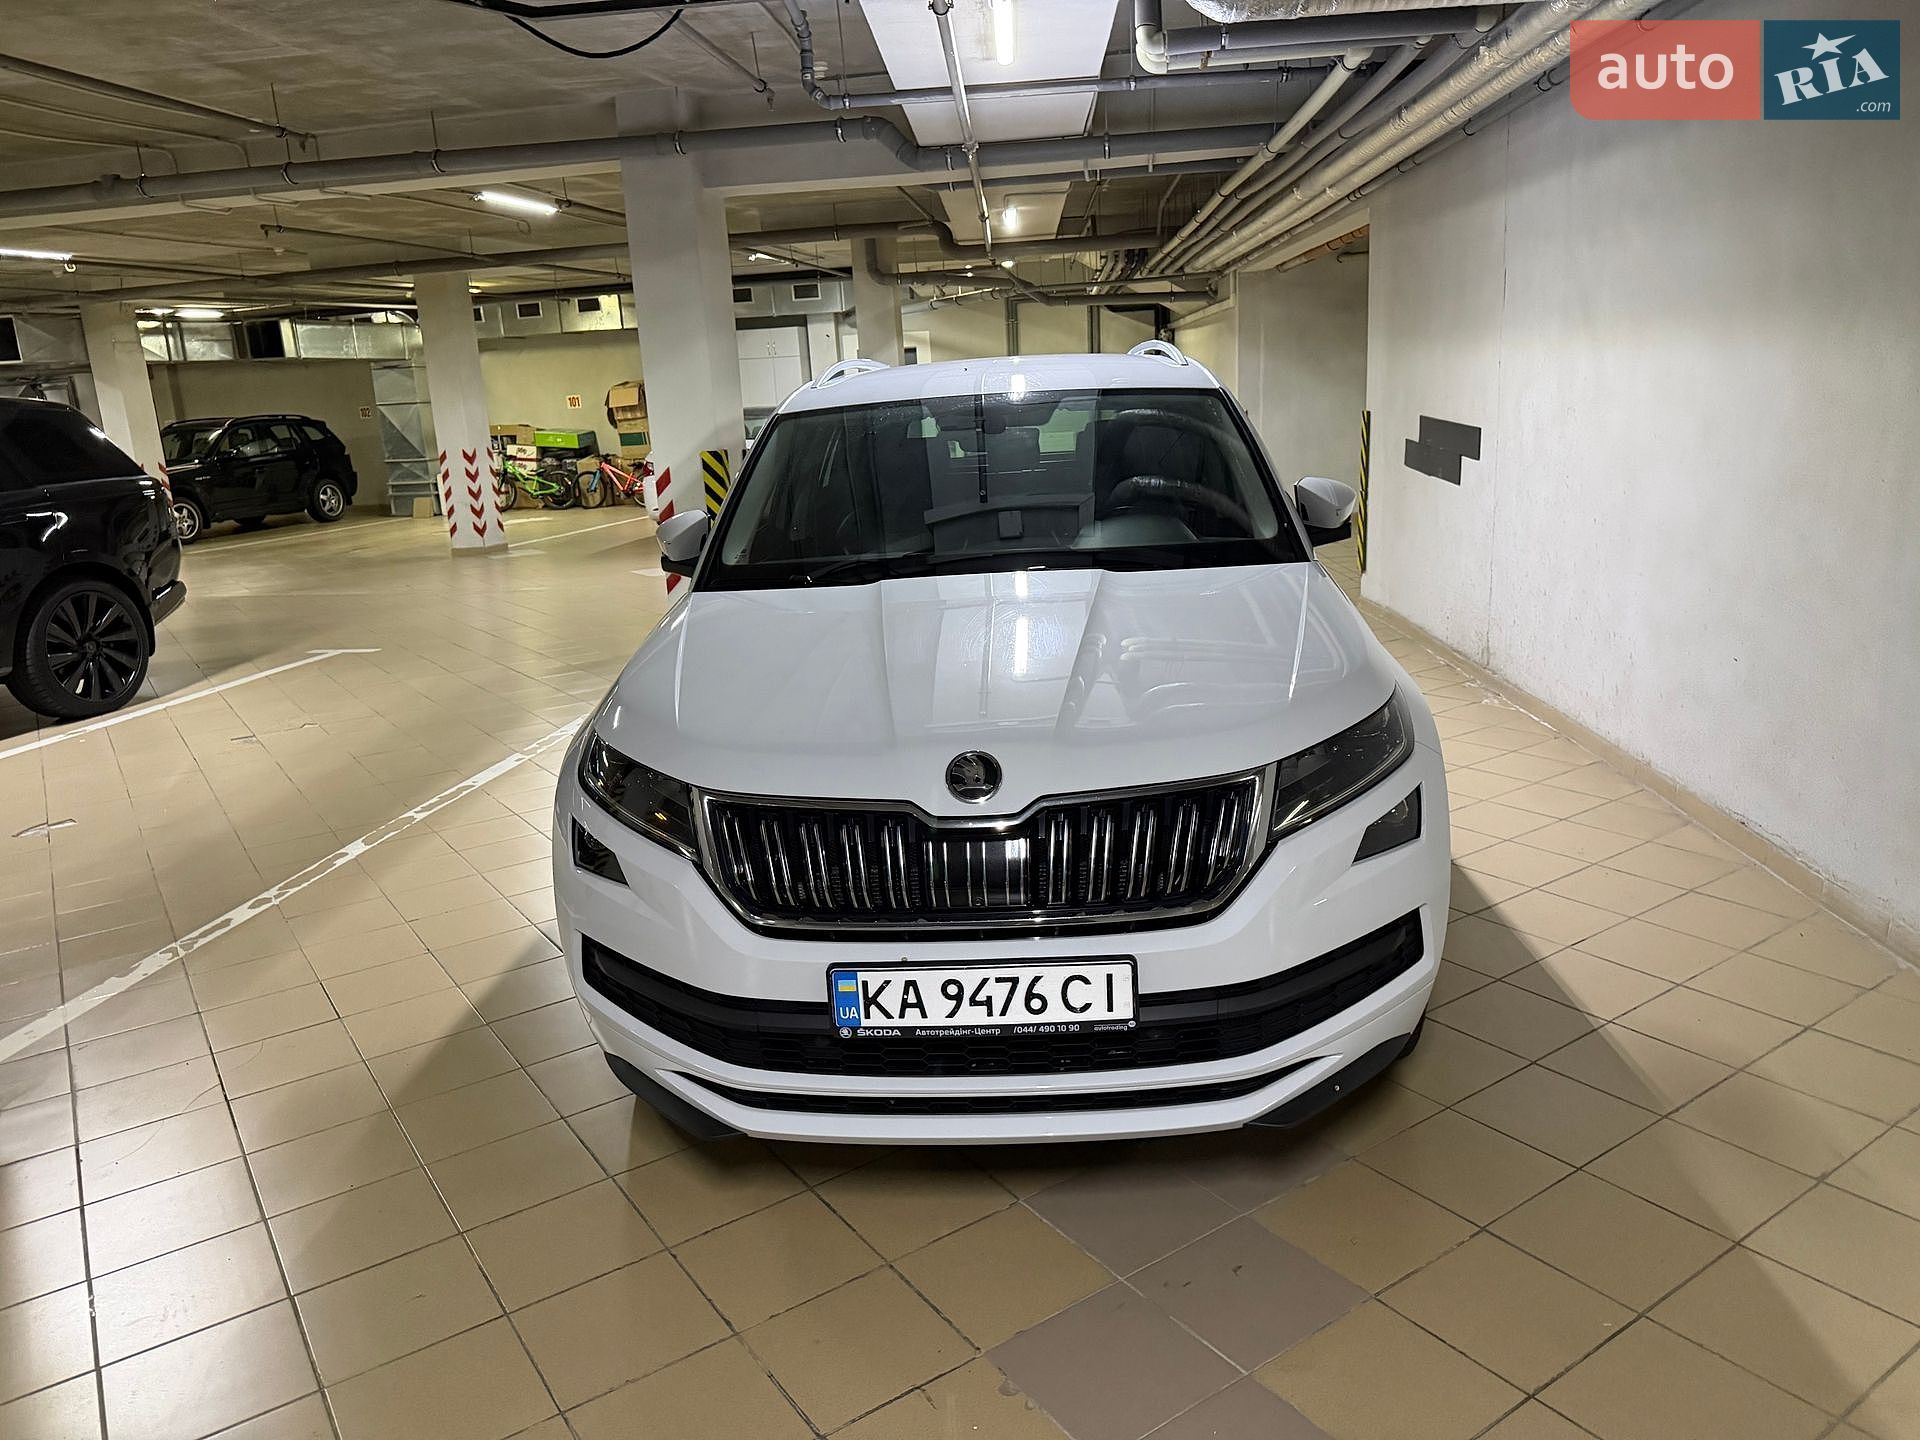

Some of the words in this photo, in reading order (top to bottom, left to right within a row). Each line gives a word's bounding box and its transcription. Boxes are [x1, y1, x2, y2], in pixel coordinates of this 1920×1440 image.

[568, 396, 581, 407] 101
[862, 979, 928, 1020] KA
[940, 975, 1049, 1018] 9476
[1061, 973, 1114, 1014] CI
[840, 1006, 859, 1020] UA
[857, 1028, 901, 1037] ŠKODA
[915, 1027, 1001, 1037] Автотрейдінг-Центр
[1013, 1025, 1036, 1034] /044/
[1038, 1025, 1056, 1033] 490
[1057, 1024, 1067, 1032] 10
[1068, 1024, 1080, 1032] 90
